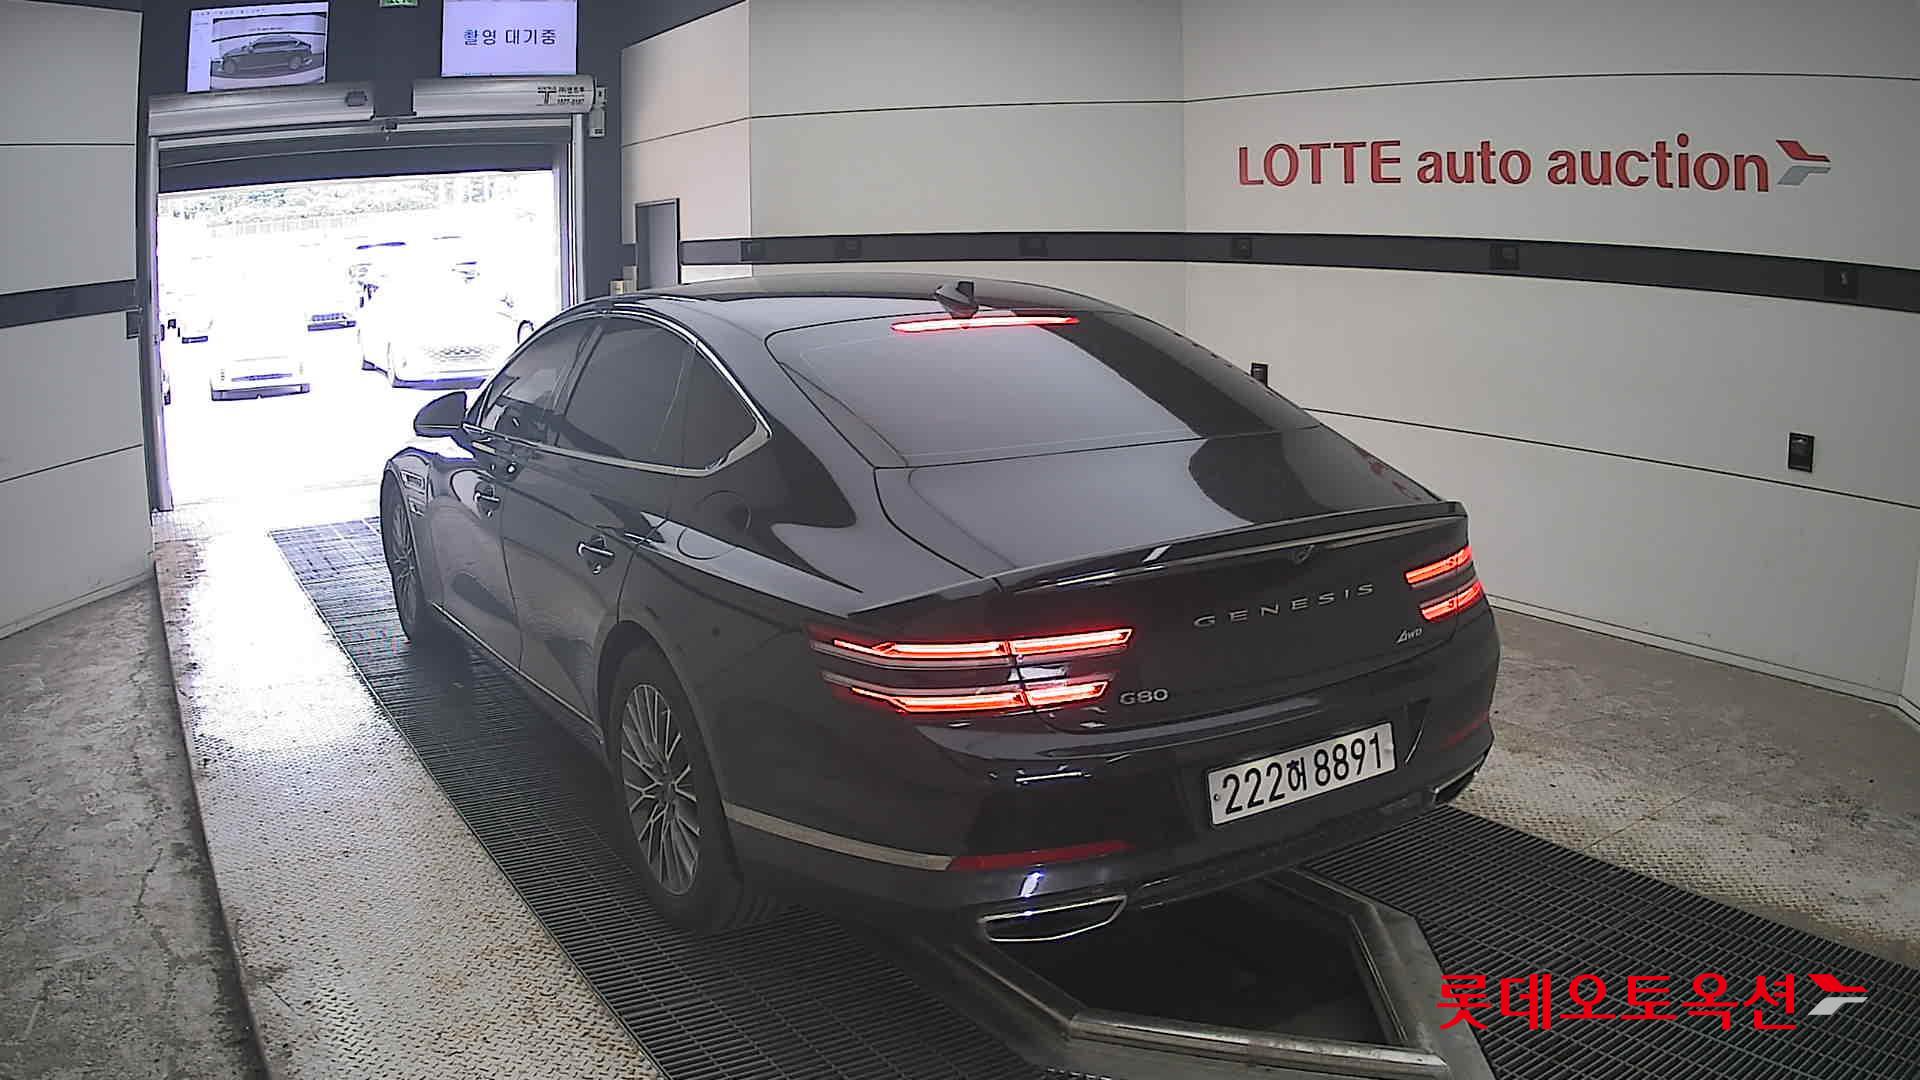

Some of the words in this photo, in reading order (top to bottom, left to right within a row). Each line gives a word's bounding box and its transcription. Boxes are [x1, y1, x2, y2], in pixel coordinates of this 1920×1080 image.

[464, 29, 496, 46] 촬영
[505, 29, 556, 45] 대기중
[1239, 140, 1401, 187] LOTTE
[1416, 140, 1532, 185] auto
[1547, 133, 1769, 193] auction
[1194, 583, 1373, 627] GENESIS
[1119, 688, 1169, 705] G80
